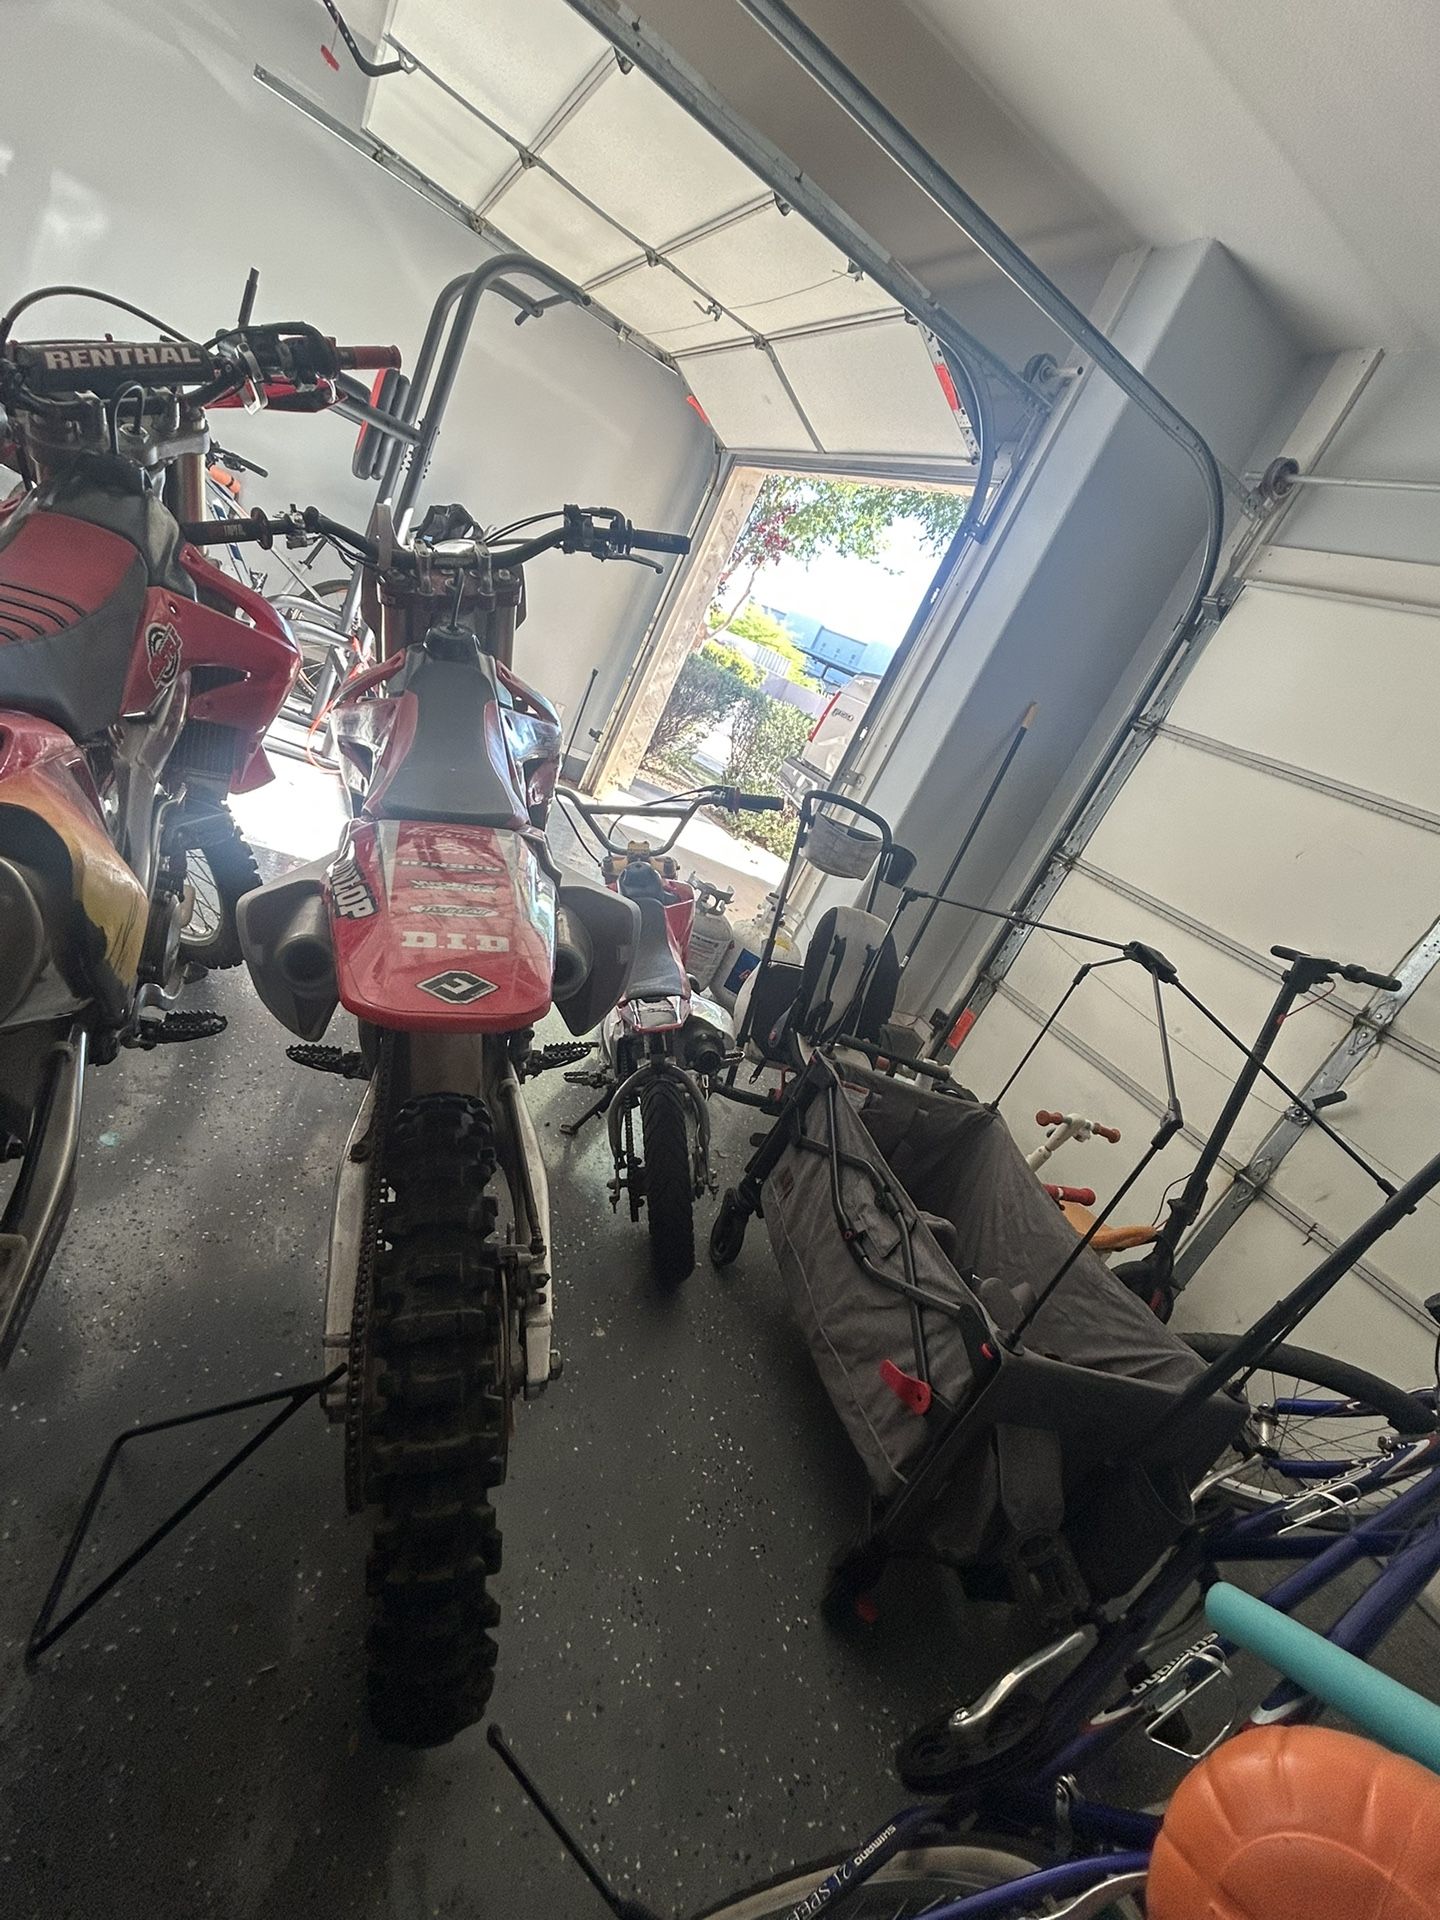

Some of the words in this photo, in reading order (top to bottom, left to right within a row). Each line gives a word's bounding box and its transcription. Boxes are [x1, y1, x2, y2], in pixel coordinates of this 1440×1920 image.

[44, 346, 201, 370] RENTHAL
[401, 931, 510, 953] D.I.D
[853, 1824, 897, 1867] SHIMANO
[835, 1863, 853, 1887] 21
[786, 1886, 832, 1920] SPEE
